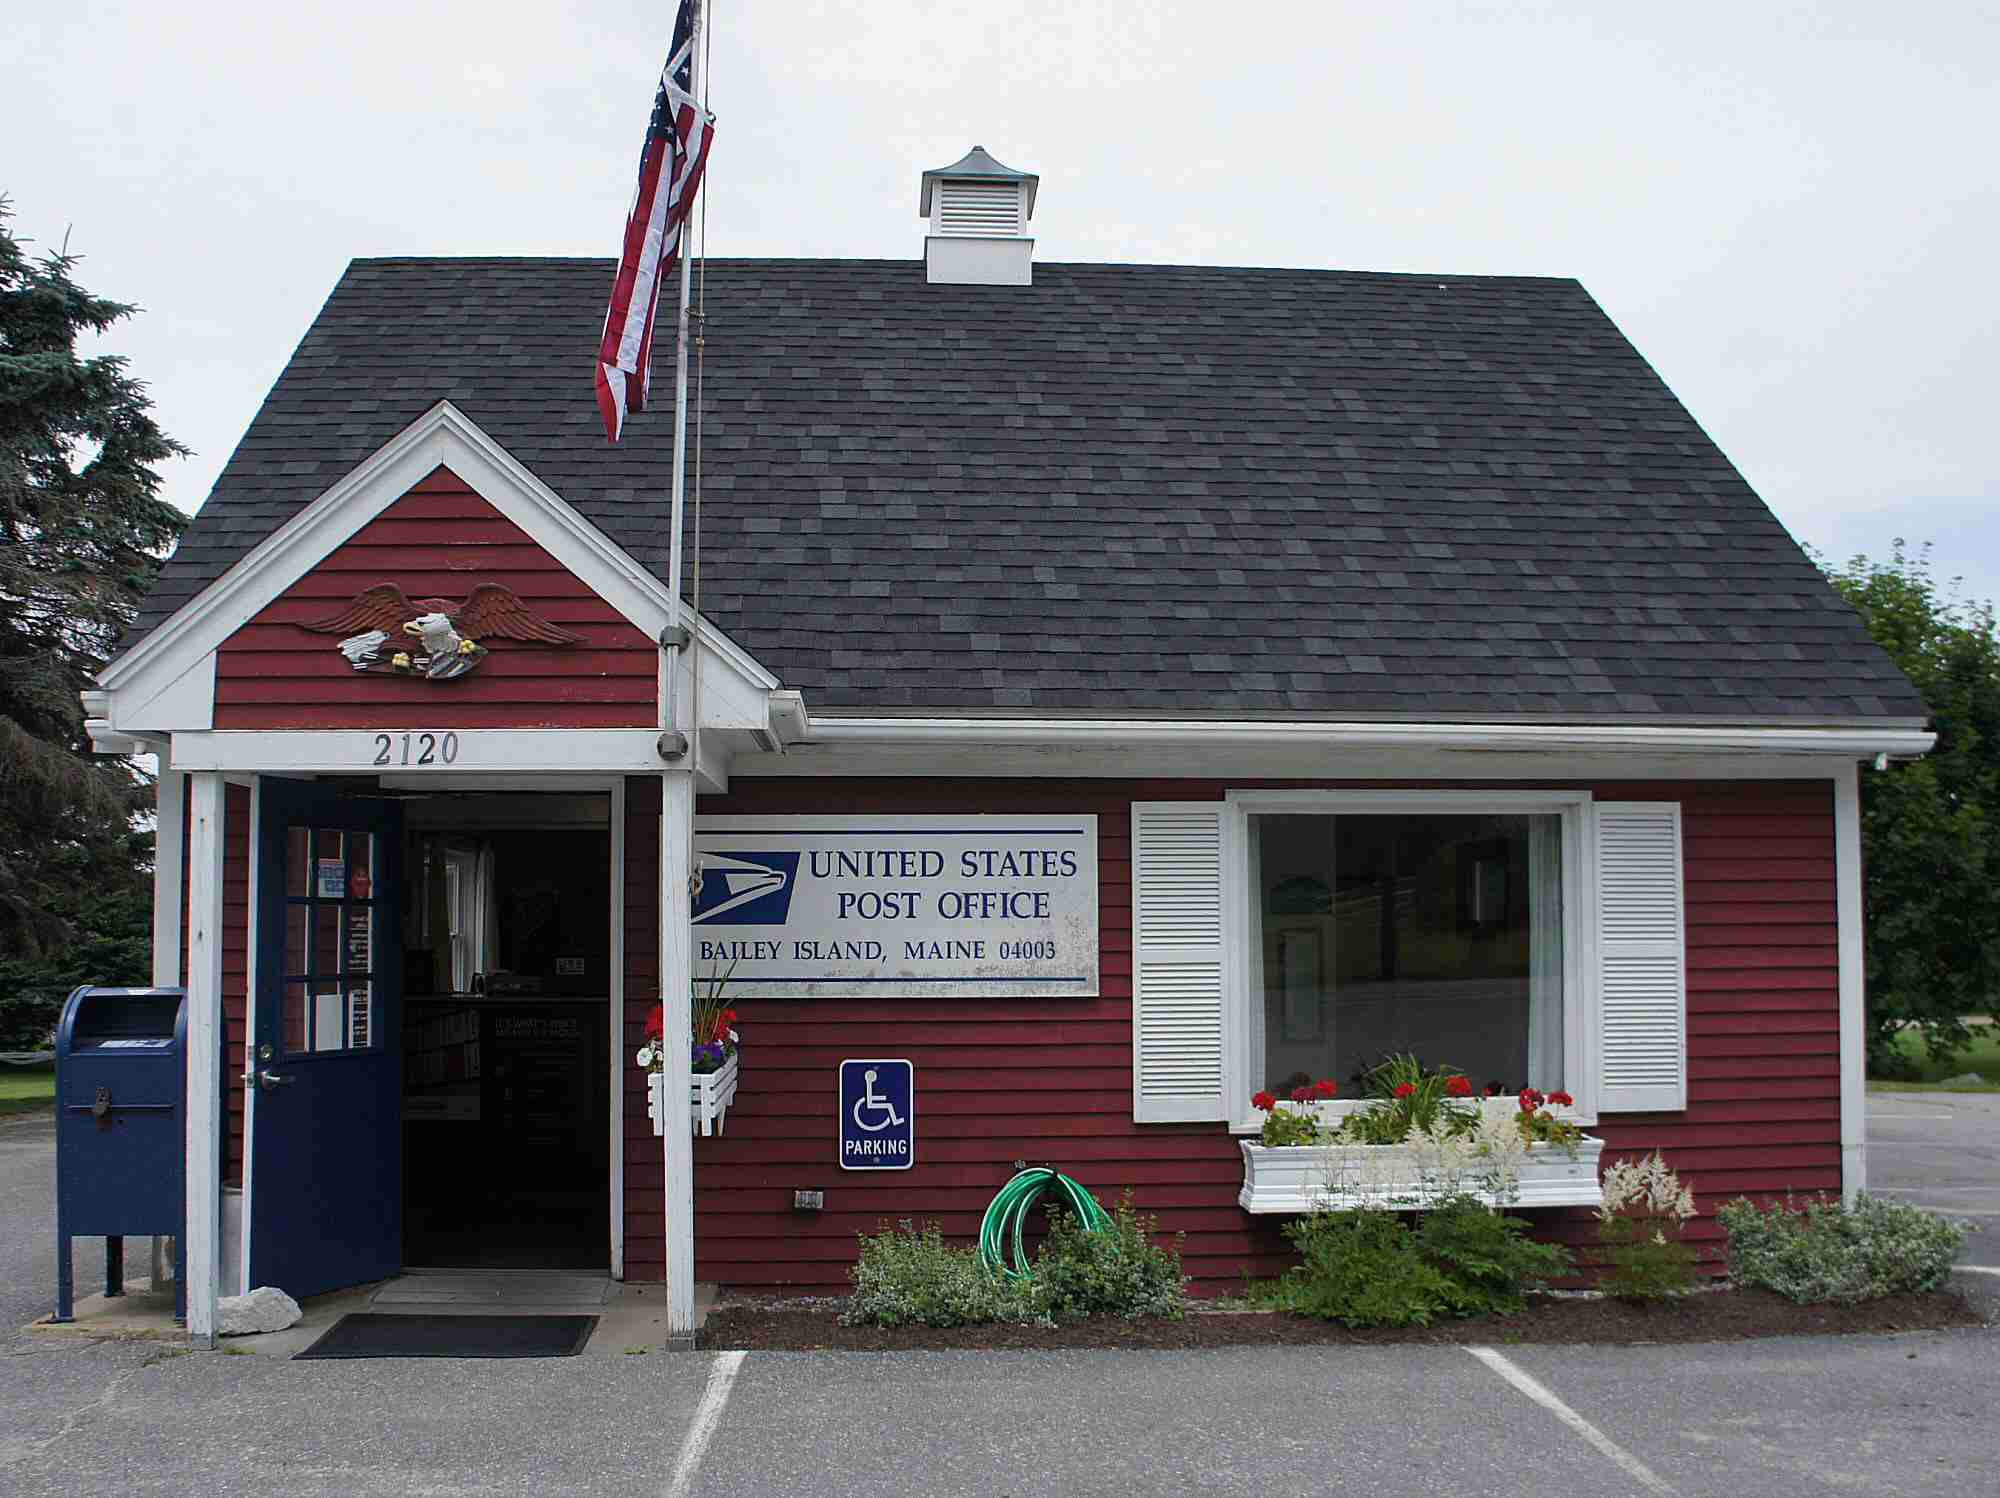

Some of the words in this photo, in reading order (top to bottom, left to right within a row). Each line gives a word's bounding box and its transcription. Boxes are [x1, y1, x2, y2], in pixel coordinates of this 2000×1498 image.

[373, 731, 459, 766] 2120
[808, 850, 944, 878] UNITED
[960, 850, 1078, 878] STATES
[837, 892, 921, 920] POST
[938, 892, 1050, 920] OFFICE
[700, 941, 782, 961] BAILEY
[793, 941, 888, 967] ISLAND,
[904, 941, 986, 960] MAINE
[999, 941, 1056, 960] 04003
[846, 1139, 907, 1156] PARKING
